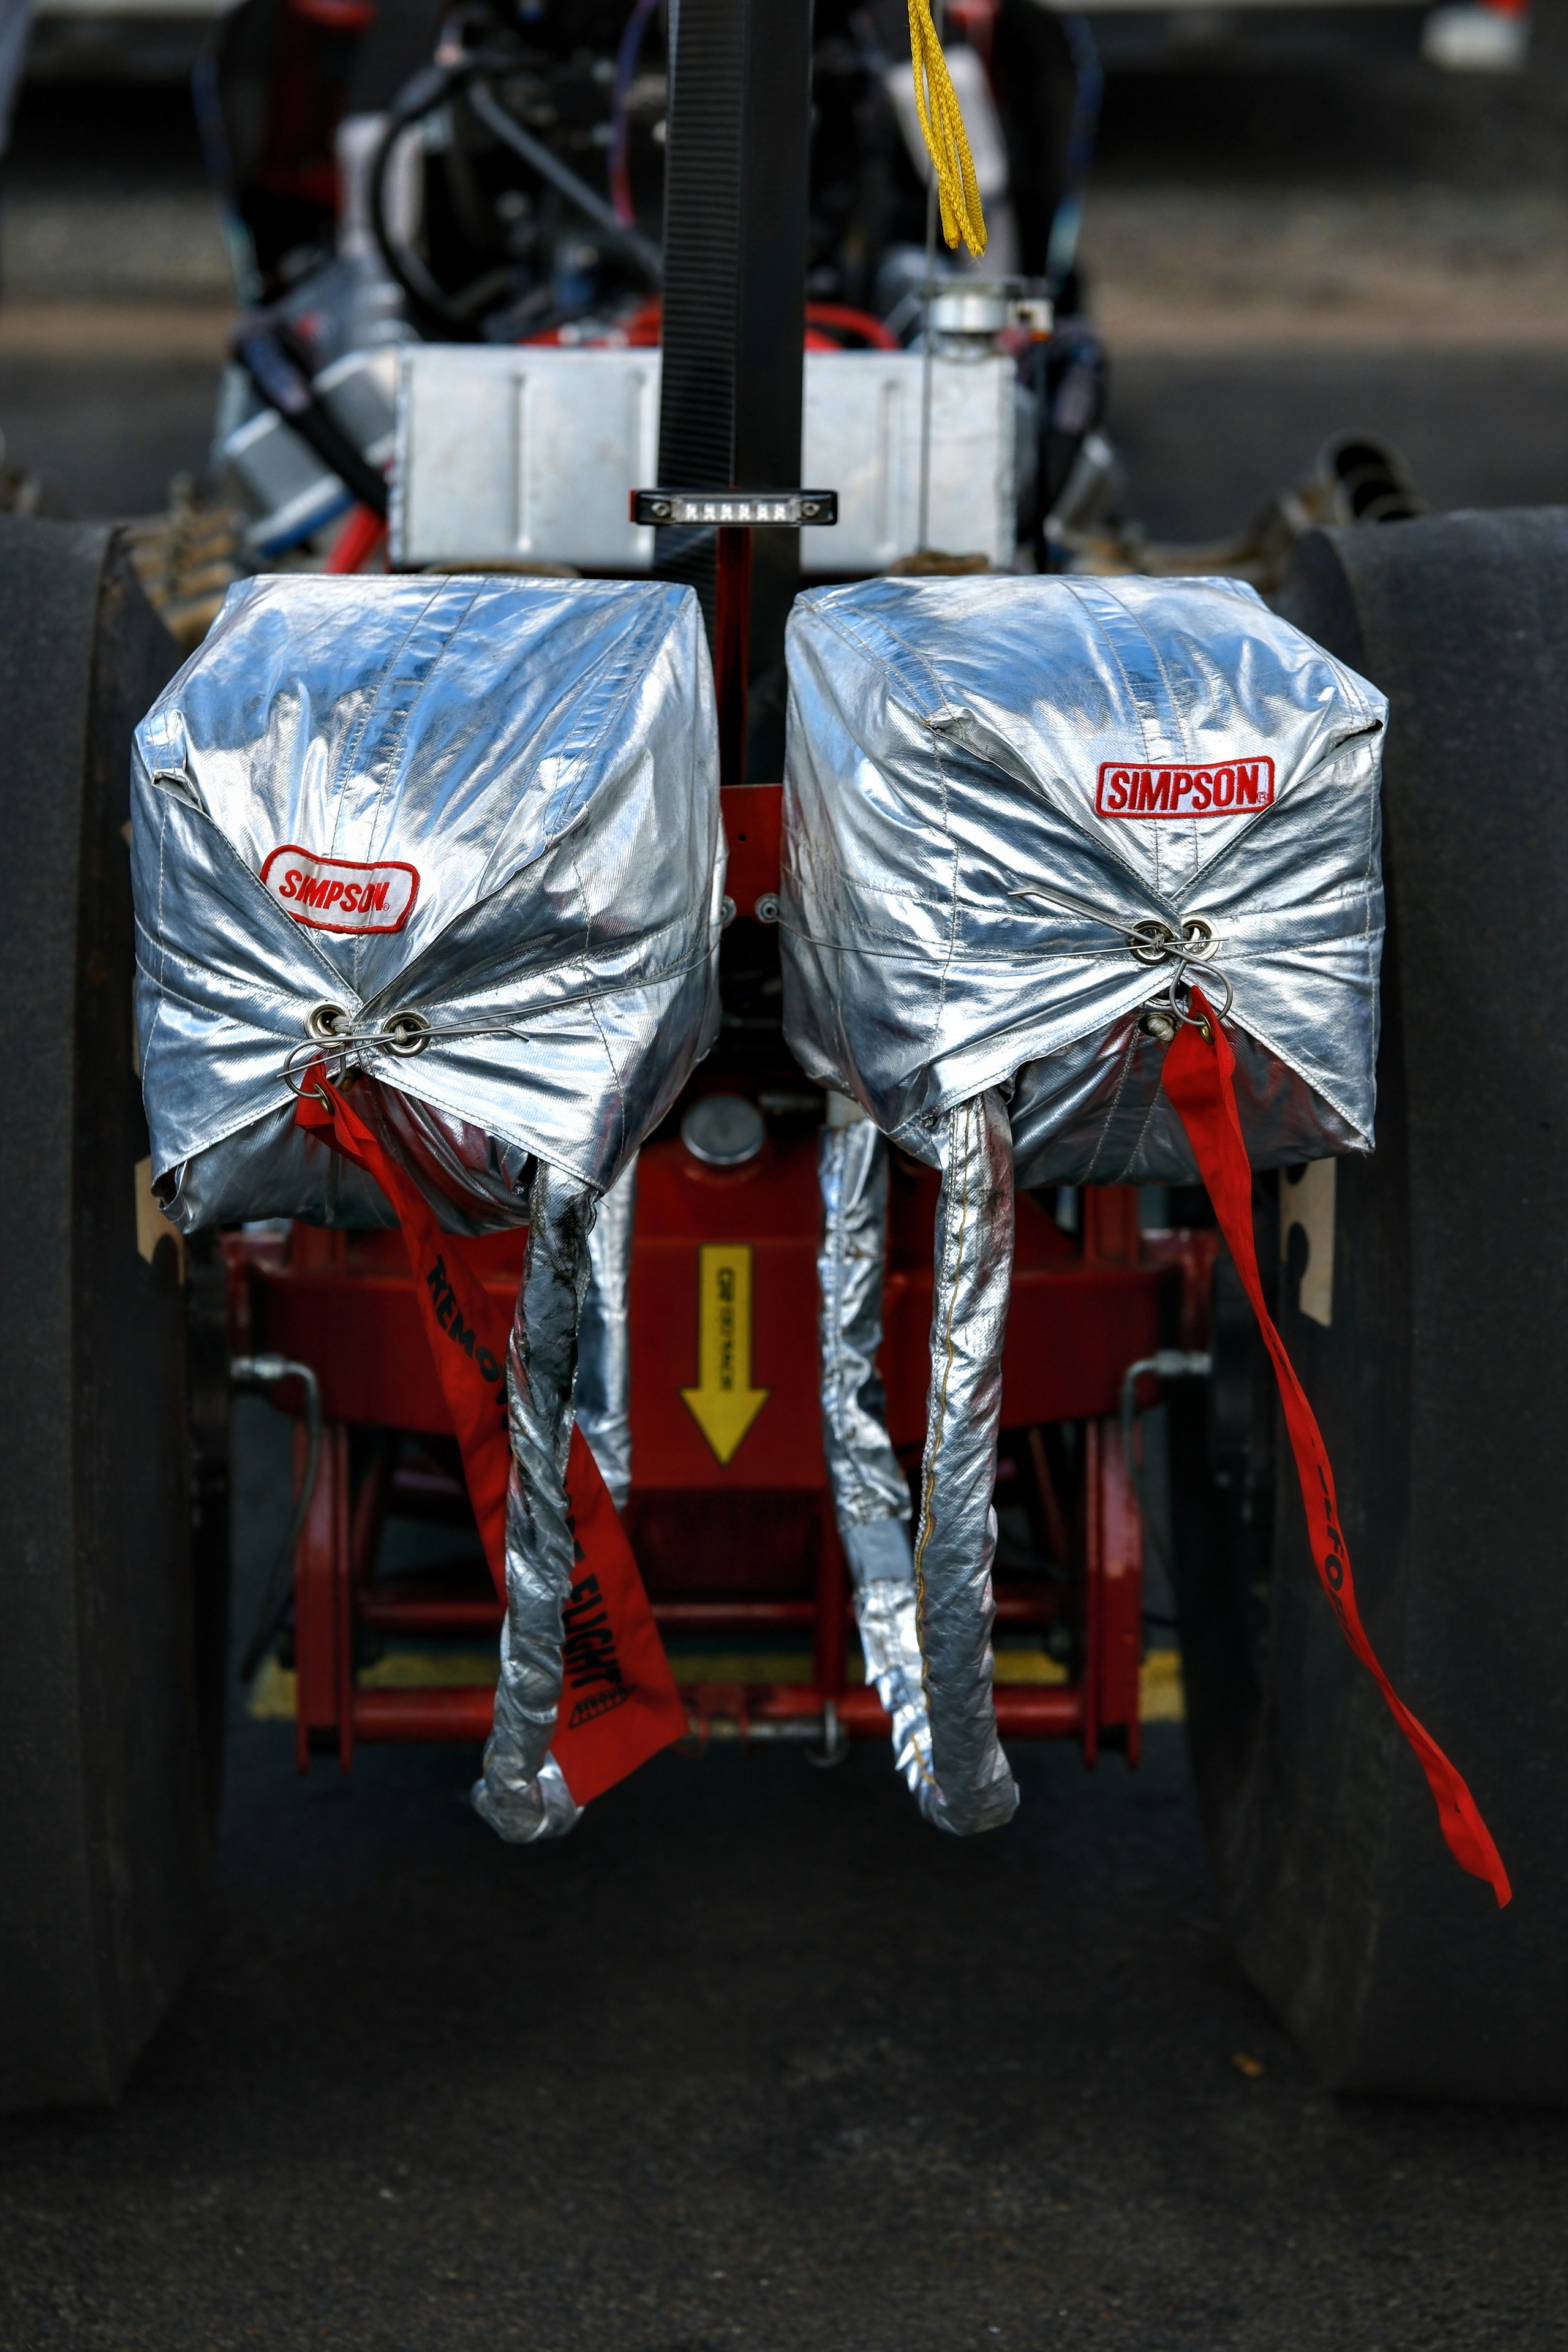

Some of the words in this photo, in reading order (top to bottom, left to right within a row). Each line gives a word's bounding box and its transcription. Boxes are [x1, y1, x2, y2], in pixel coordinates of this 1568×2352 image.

[1107, 764, 1259, 810] SIMPSON
[279, 869, 390, 913] SIMPSON
[426, 1253, 508, 1431] REMO
[562, 1572, 623, 1689] FLIGHT
